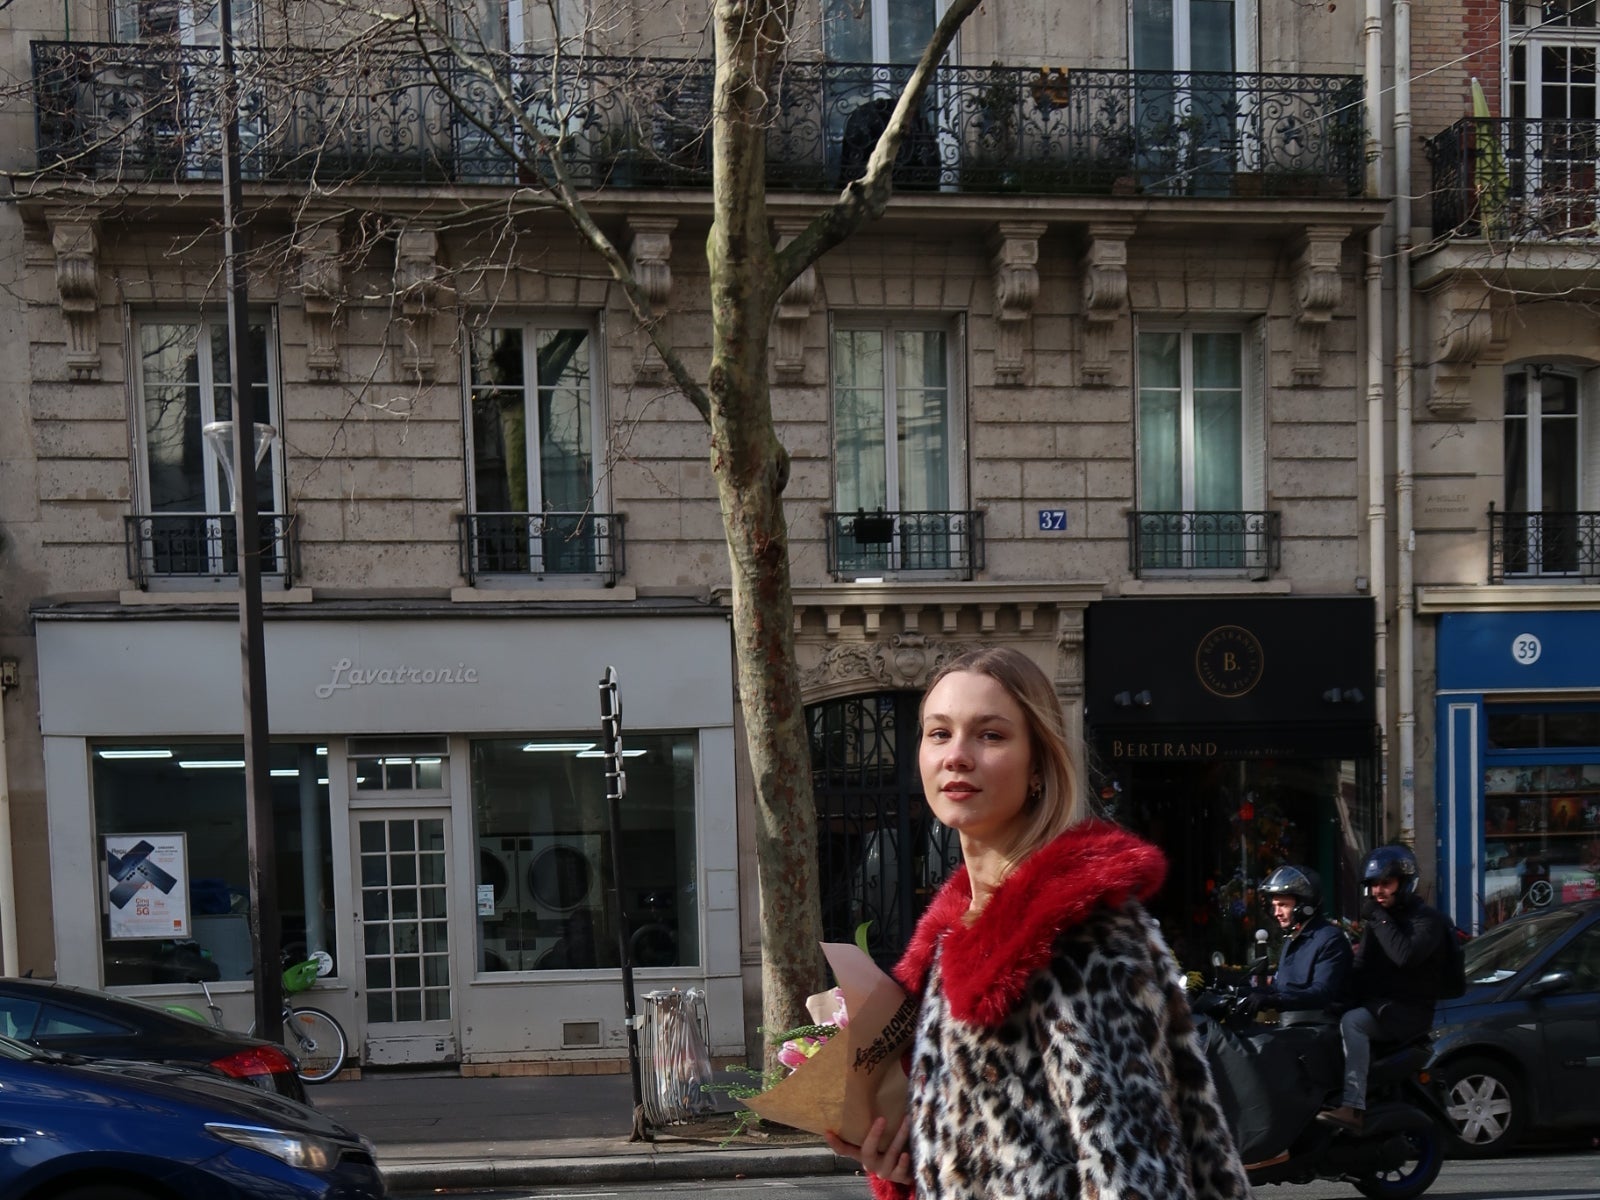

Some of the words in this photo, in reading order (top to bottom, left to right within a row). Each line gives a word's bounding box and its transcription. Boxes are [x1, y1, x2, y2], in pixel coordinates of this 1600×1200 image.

[1041, 511, 1065, 529] 37
[1518, 641, 1537, 659] 39
[314, 657, 480, 699] Lavatronic
[136, 906, 150, 915] 5G
